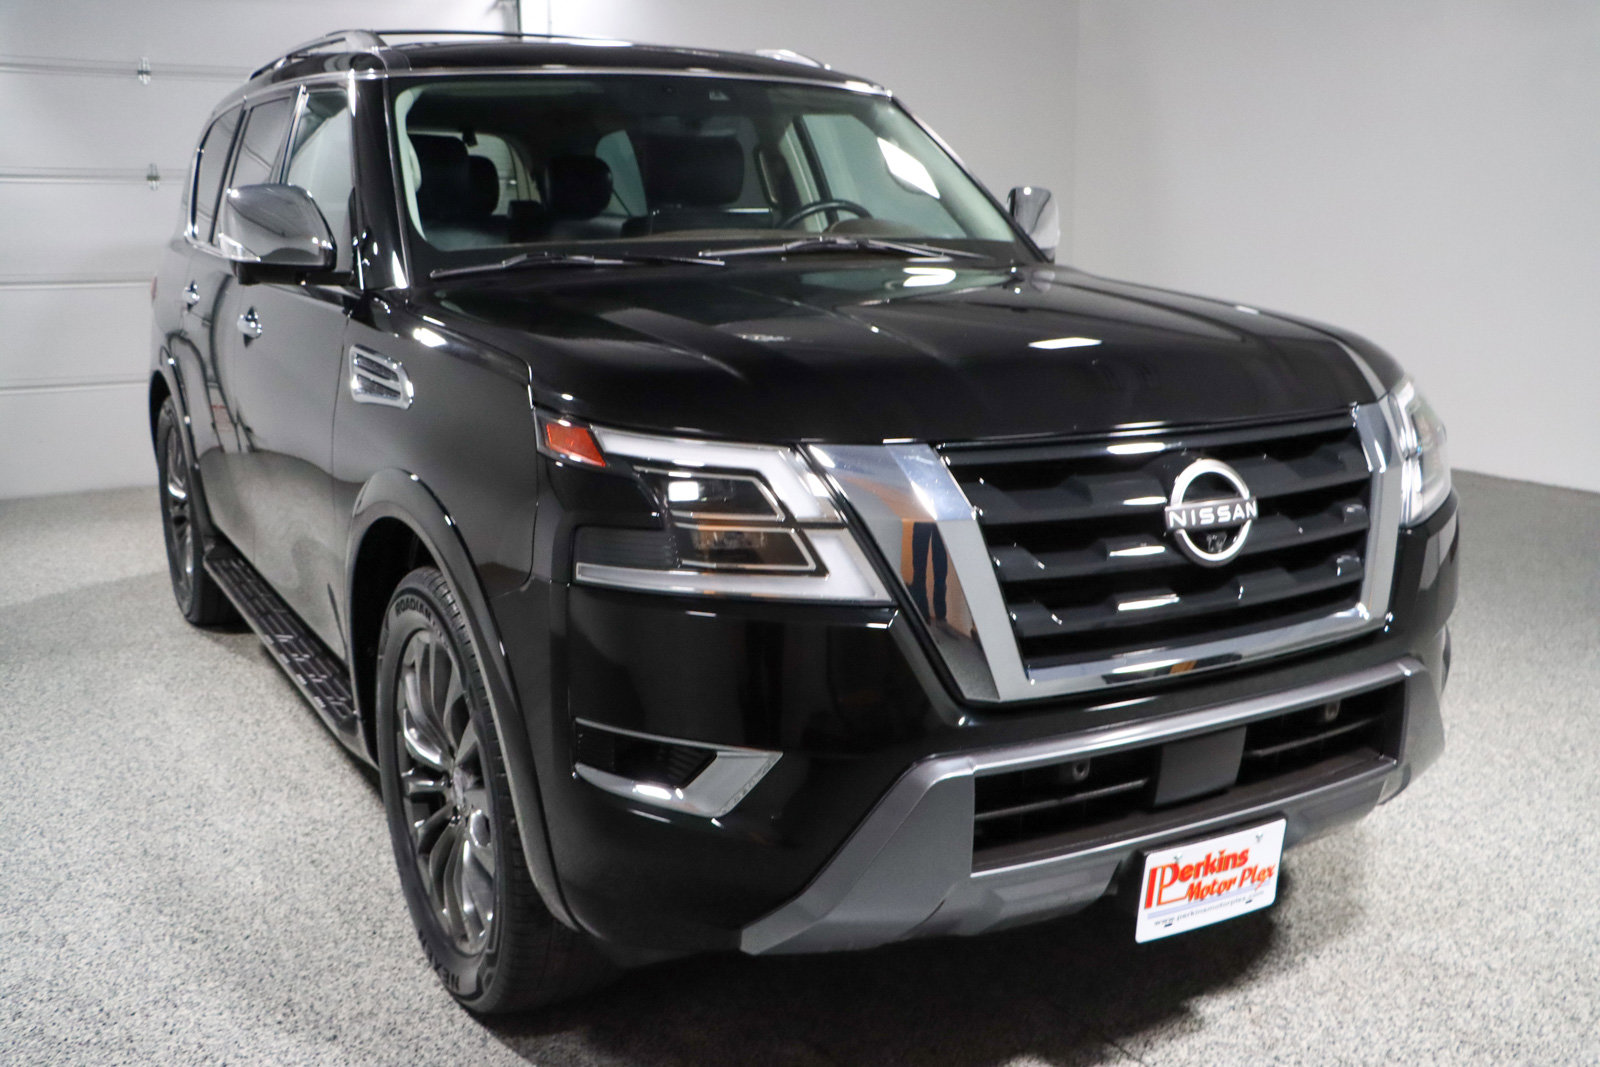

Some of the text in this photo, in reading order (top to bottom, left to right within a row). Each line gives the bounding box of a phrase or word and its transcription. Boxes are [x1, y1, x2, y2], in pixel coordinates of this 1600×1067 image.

[1168, 499, 1258, 528] NISSAN
[1144, 848, 1250, 909] Perkins
[1185, 864, 1276, 903] Motor Plex
